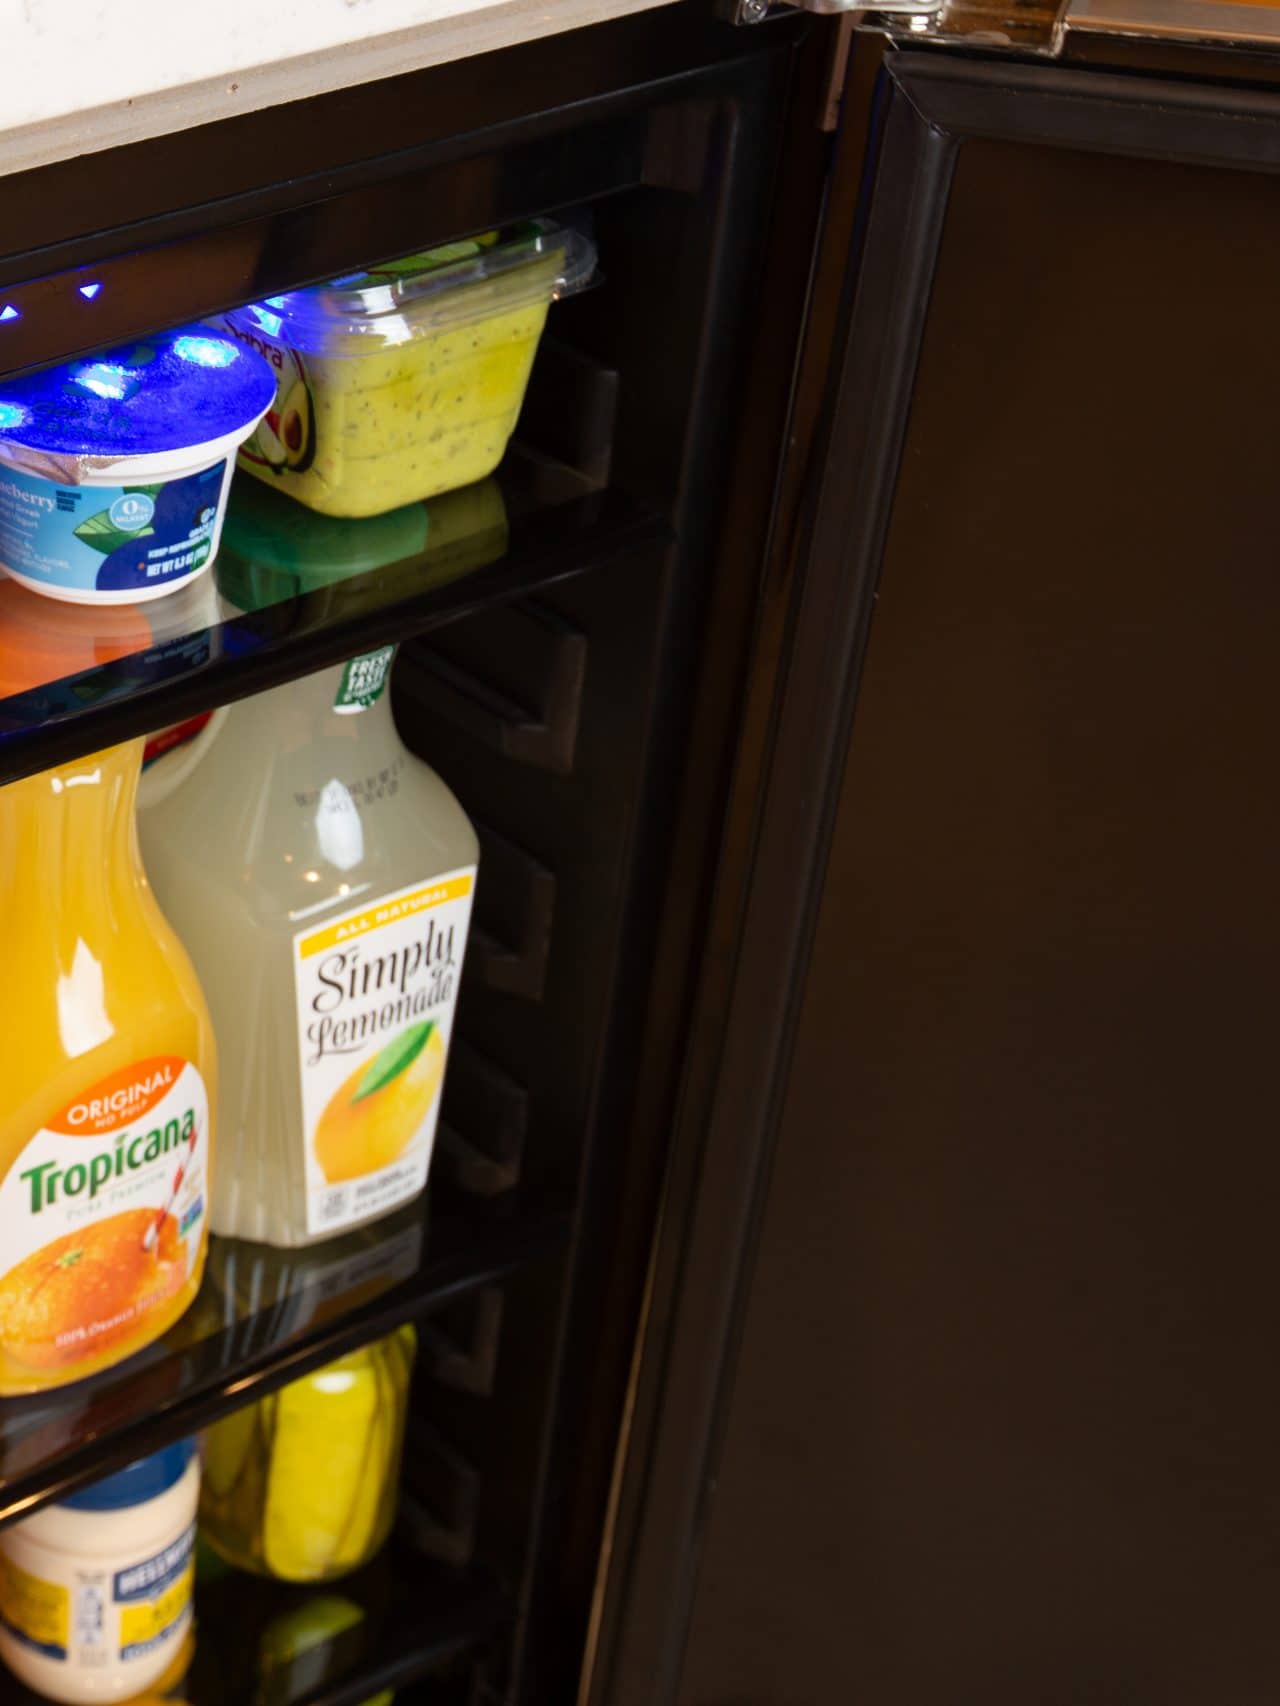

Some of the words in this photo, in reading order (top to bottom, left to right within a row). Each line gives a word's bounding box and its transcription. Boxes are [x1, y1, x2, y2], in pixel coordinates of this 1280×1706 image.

[335, 917, 370, 940] ALL
[375, 887, 448, 924] NATURAL
[312, 919, 456, 1014] Simply
[306, 970, 454, 1067] Lemonade
[67, 1065, 173, 1126] ORIGINAL
[20, 1108, 196, 1214] Tropicana
